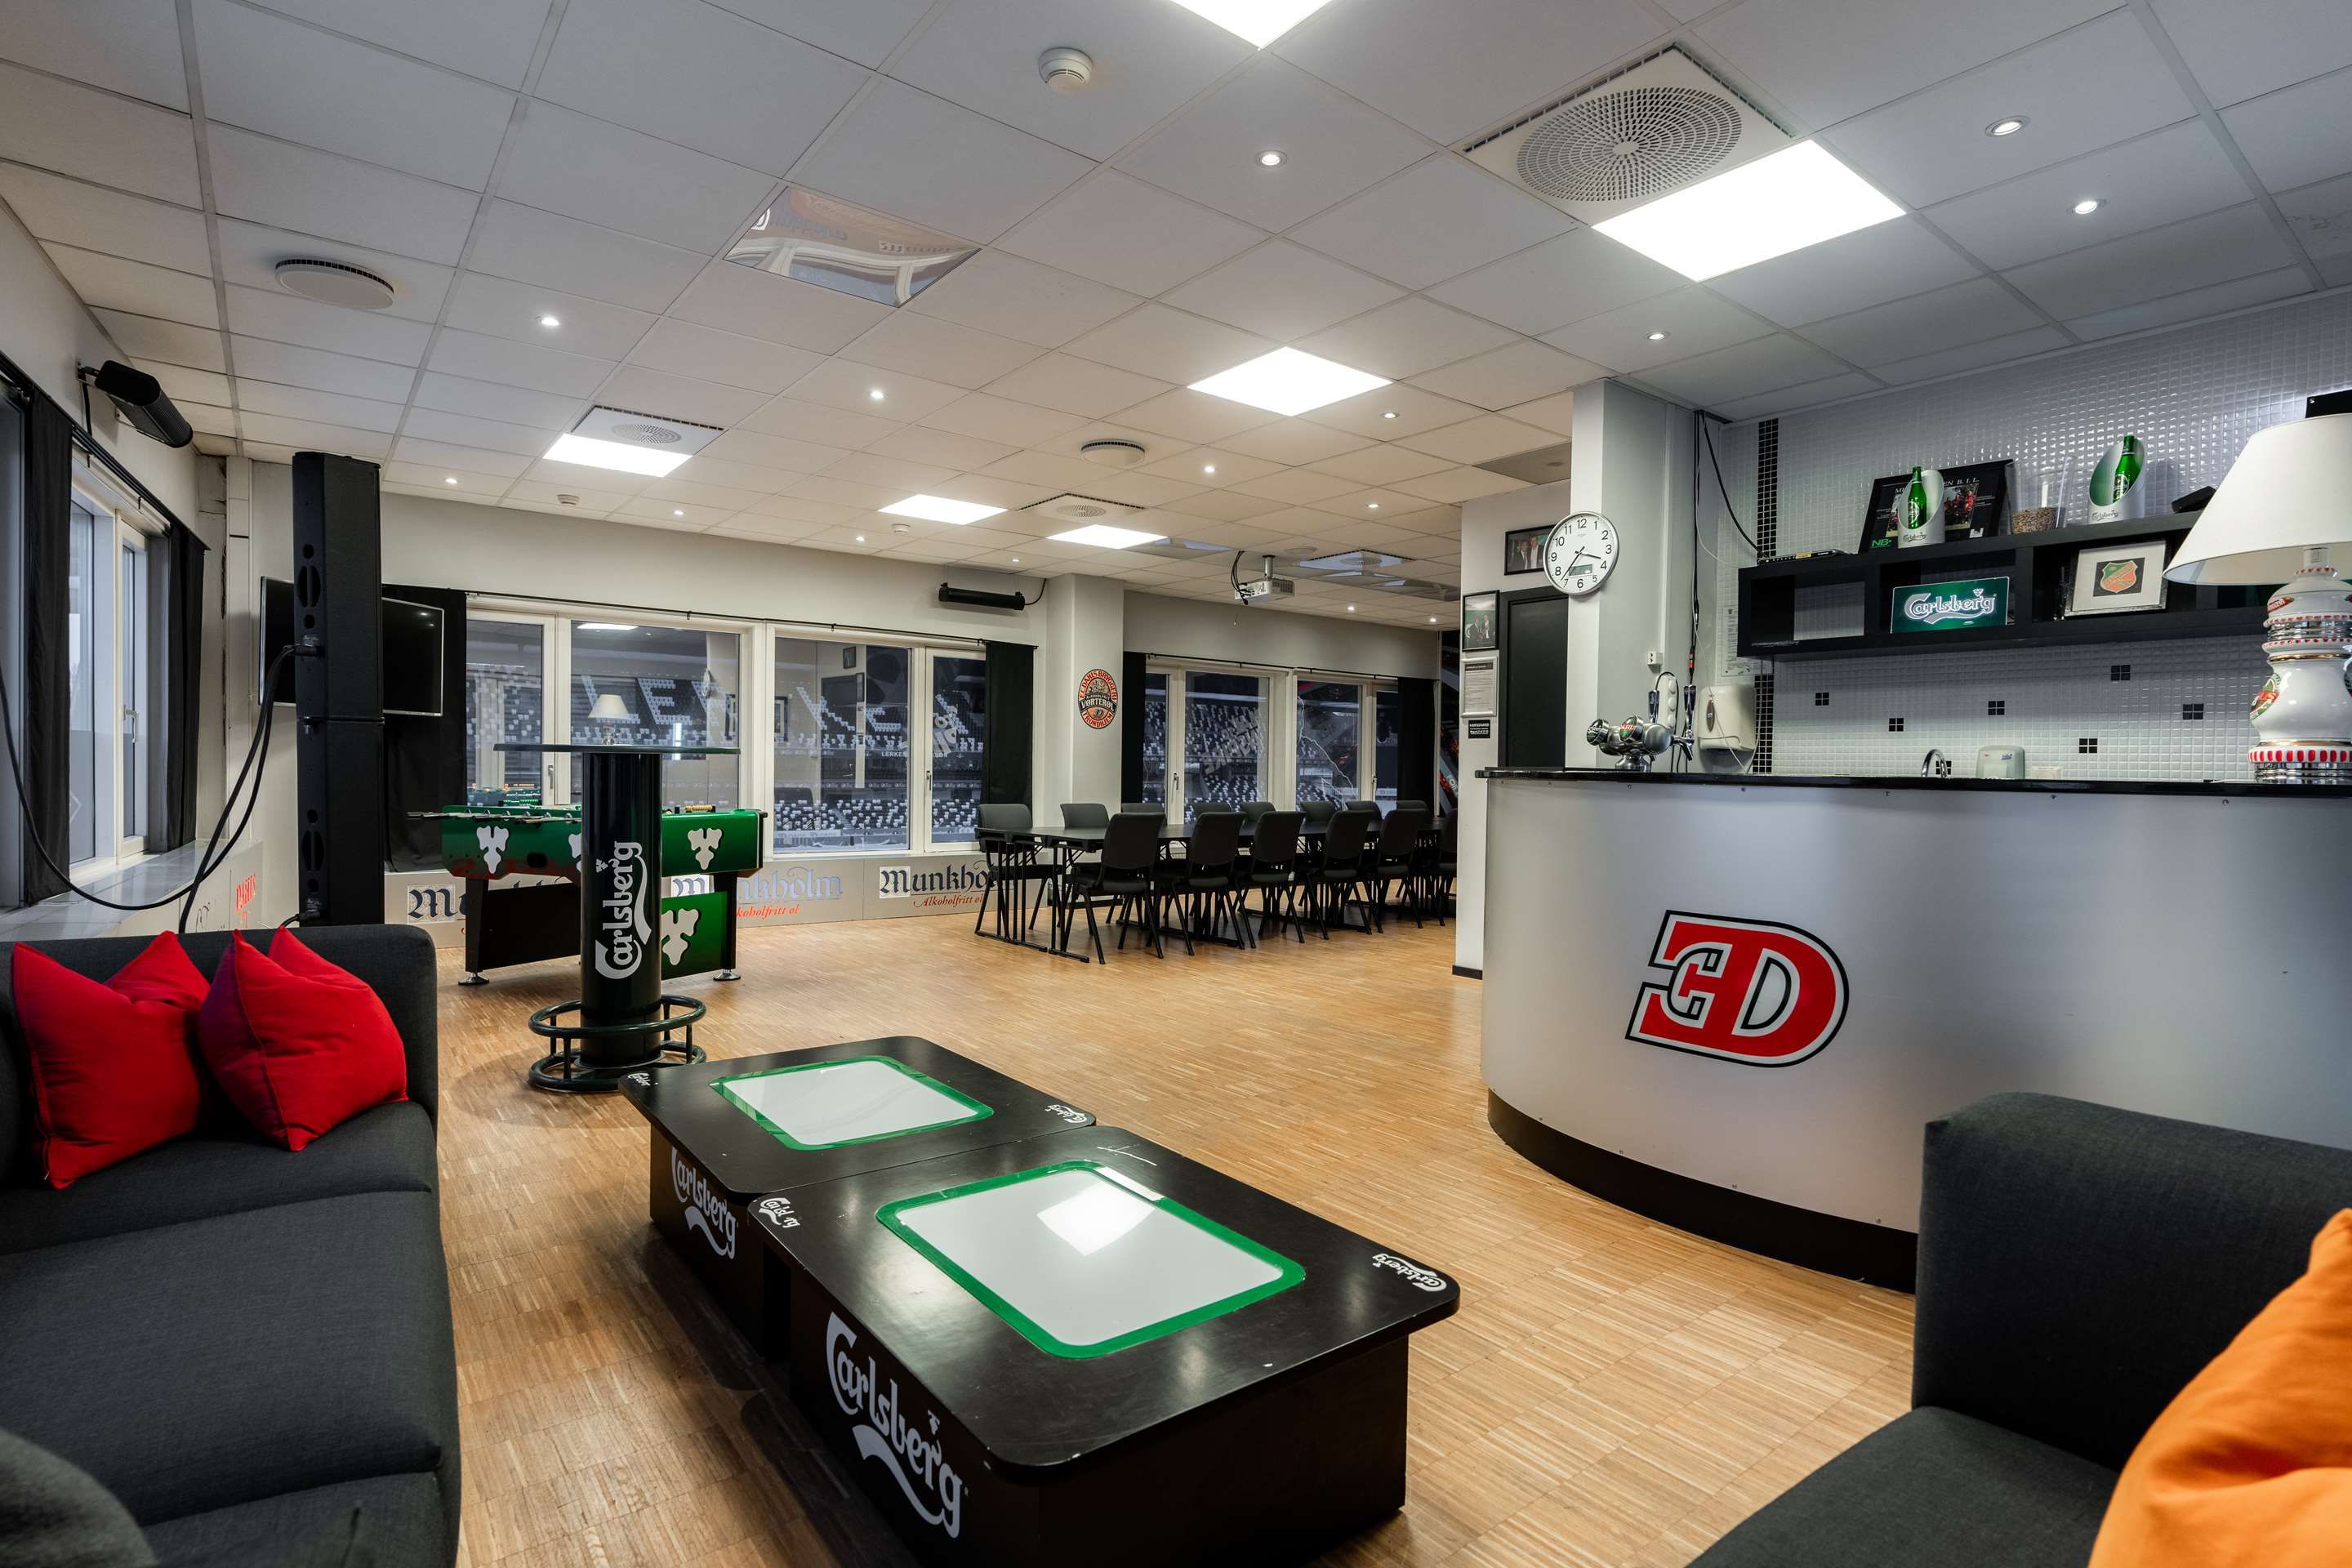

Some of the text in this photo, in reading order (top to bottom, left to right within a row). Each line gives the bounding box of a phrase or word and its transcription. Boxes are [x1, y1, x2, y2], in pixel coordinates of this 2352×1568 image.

[1577, 519, 1587, 529] 12
[1594, 521, 1597, 530] 1
[1564, 525, 1572, 535] 11
[1601, 530, 1609, 540] 2
[1555, 537, 1565, 546] 10
[1606, 545, 1612, 554] 3
[1551, 552, 1557, 562] 9
[1601, 561, 1607, 570] 4
[1555, 567, 1561, 576] 8
[1577, 579, 1584, 588] 6
[1904, 587, 1997, 625] Carlsberg
[880, 863, 988, 894] Munkho
[595, 841, 653, 979] Carlsberg
[737, 903, 786, 921] koholfritt
[671, 1146, 739, 1260] Carlsberg
[1372, 1253, 1447, 1292] Carlsberg
[826, 1311, 964, 1539] Carlsberg
